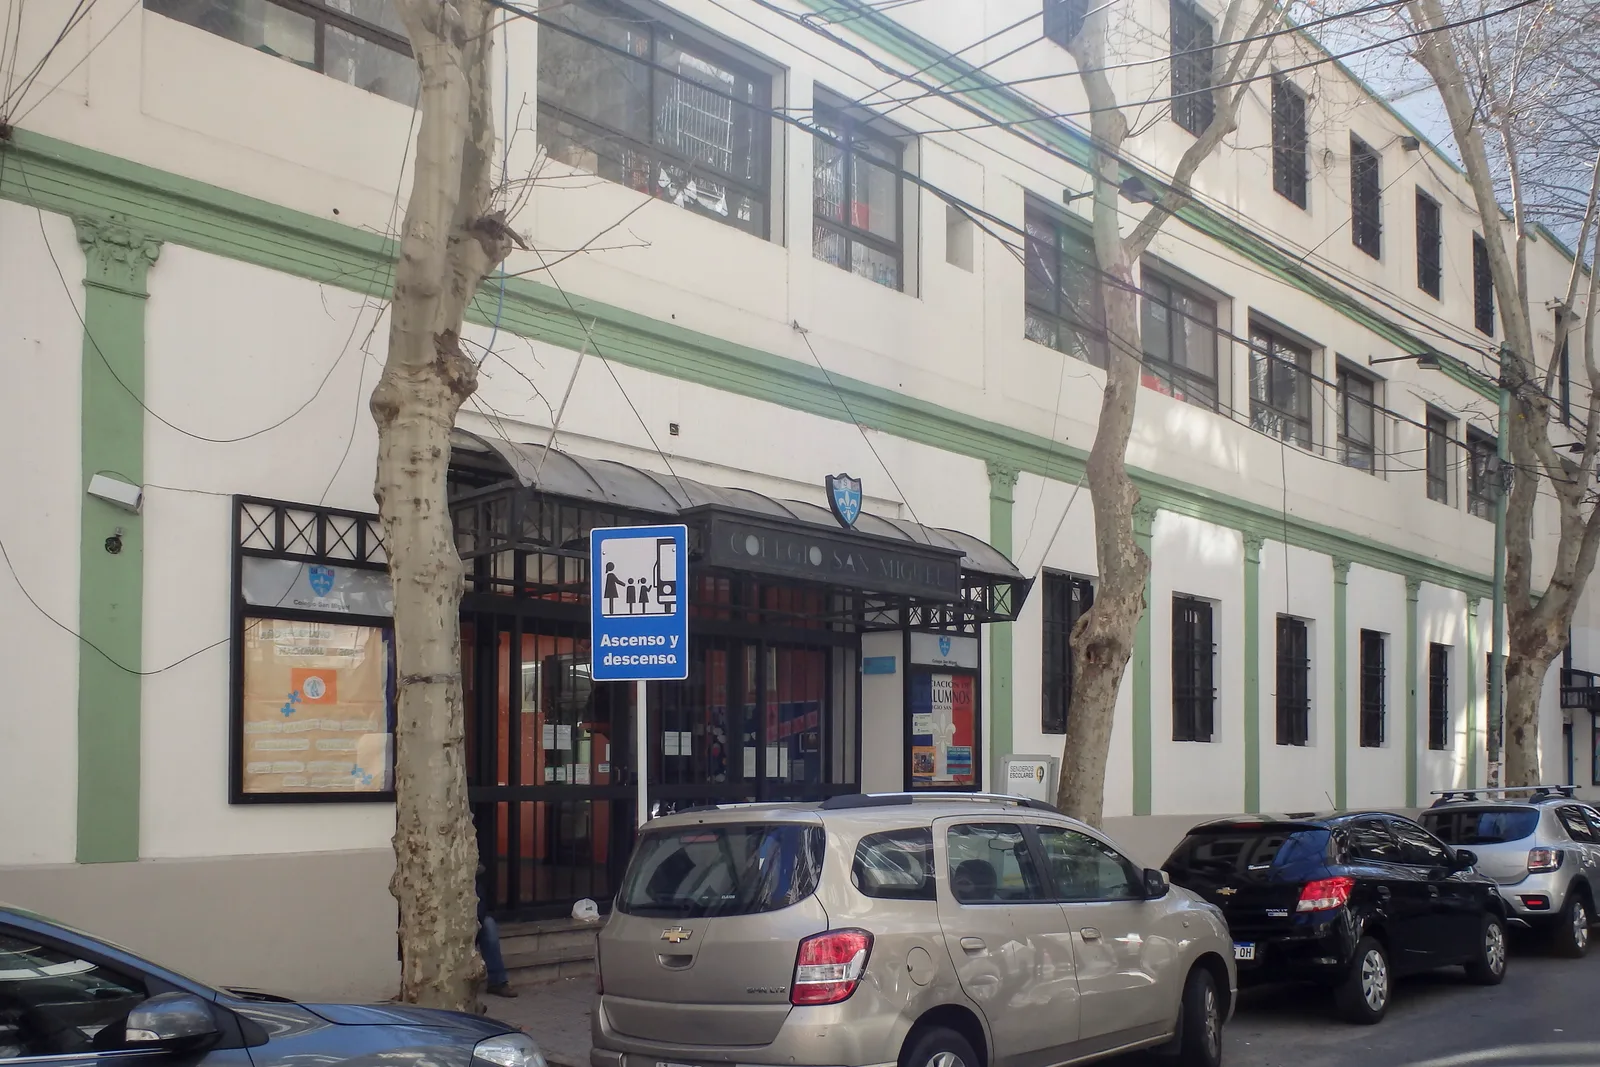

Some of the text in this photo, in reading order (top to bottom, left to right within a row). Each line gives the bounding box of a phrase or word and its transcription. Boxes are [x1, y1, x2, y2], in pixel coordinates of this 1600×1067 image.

[731, 533, 943, 587] COLEGIO SAN MIGUEL
[600, 633, 679, 649] Ascenso y
[603, 652, 676, 666] descenso
